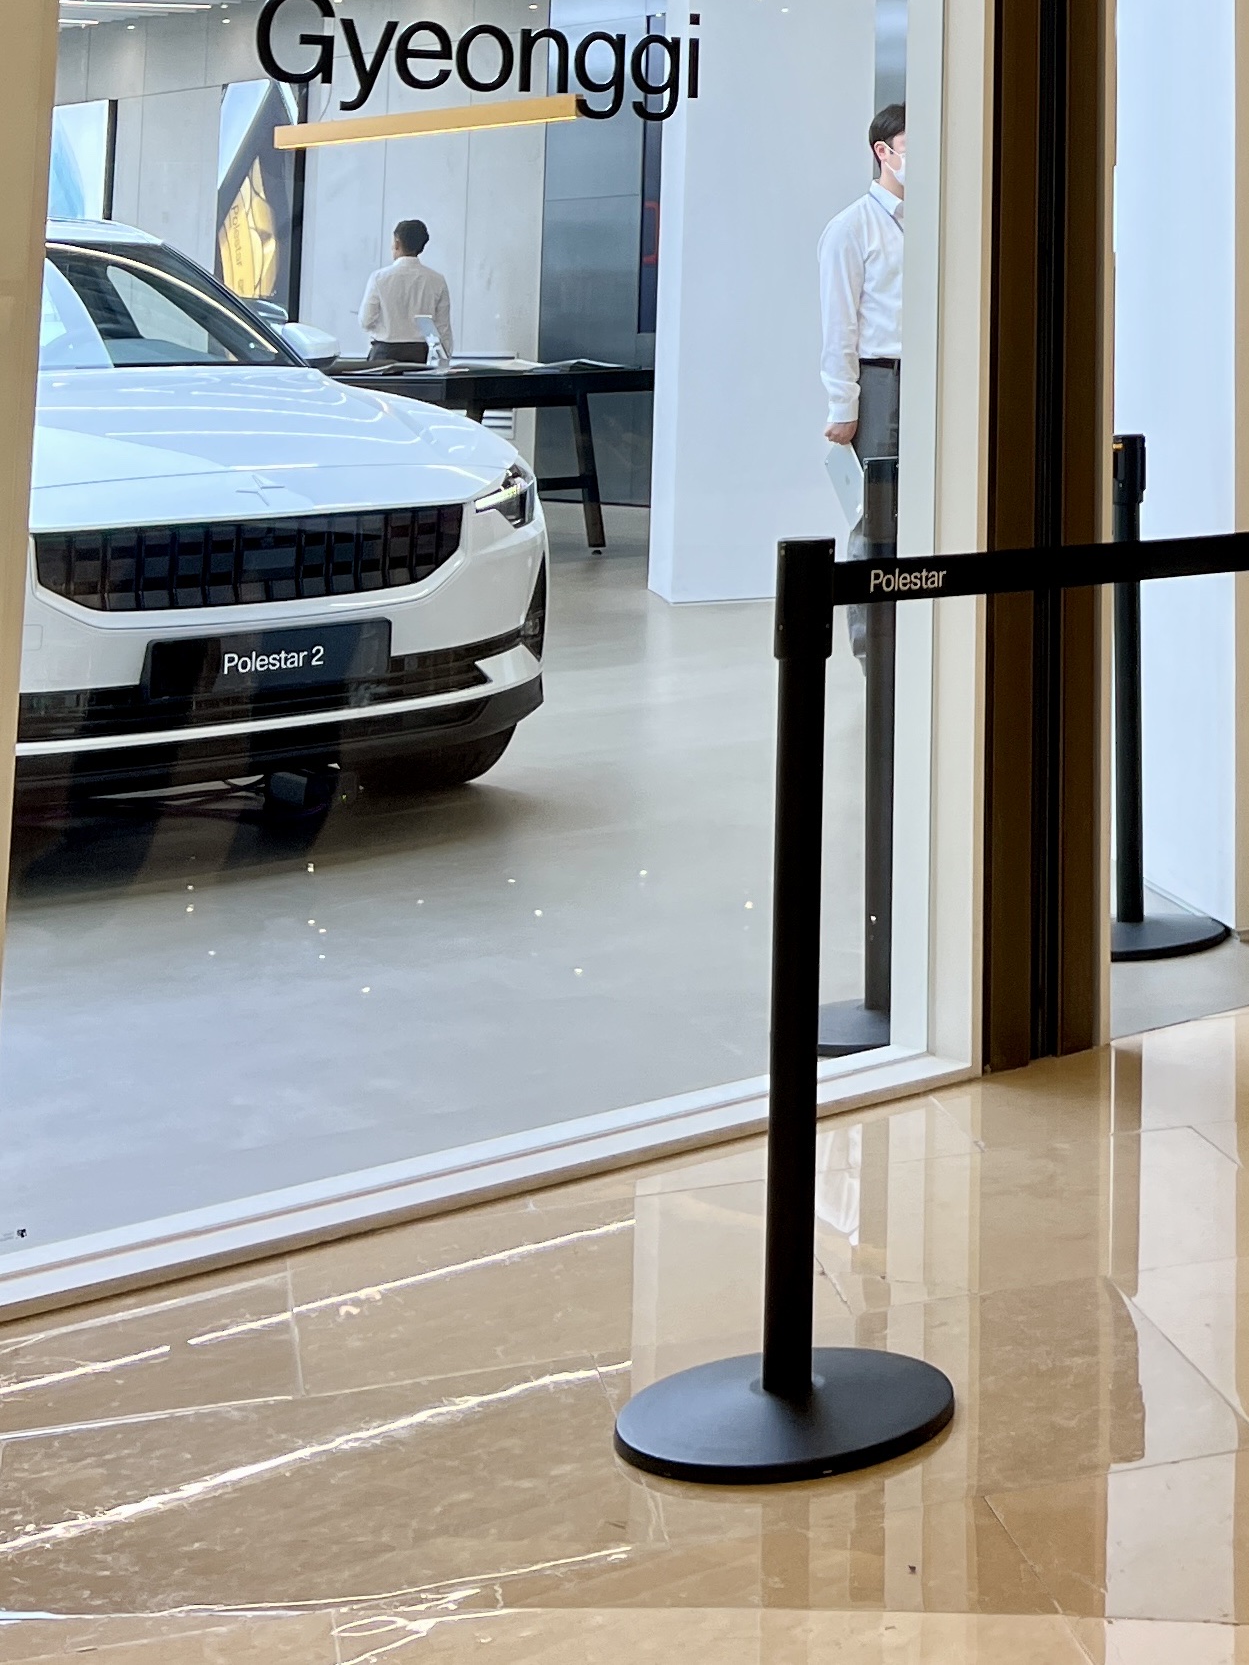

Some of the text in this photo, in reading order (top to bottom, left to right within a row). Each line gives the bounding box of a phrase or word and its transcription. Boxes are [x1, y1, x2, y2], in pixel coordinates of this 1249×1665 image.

[869, 567, 948, 594] Polestar
[223, 645, 325, 675] Polestar 2
